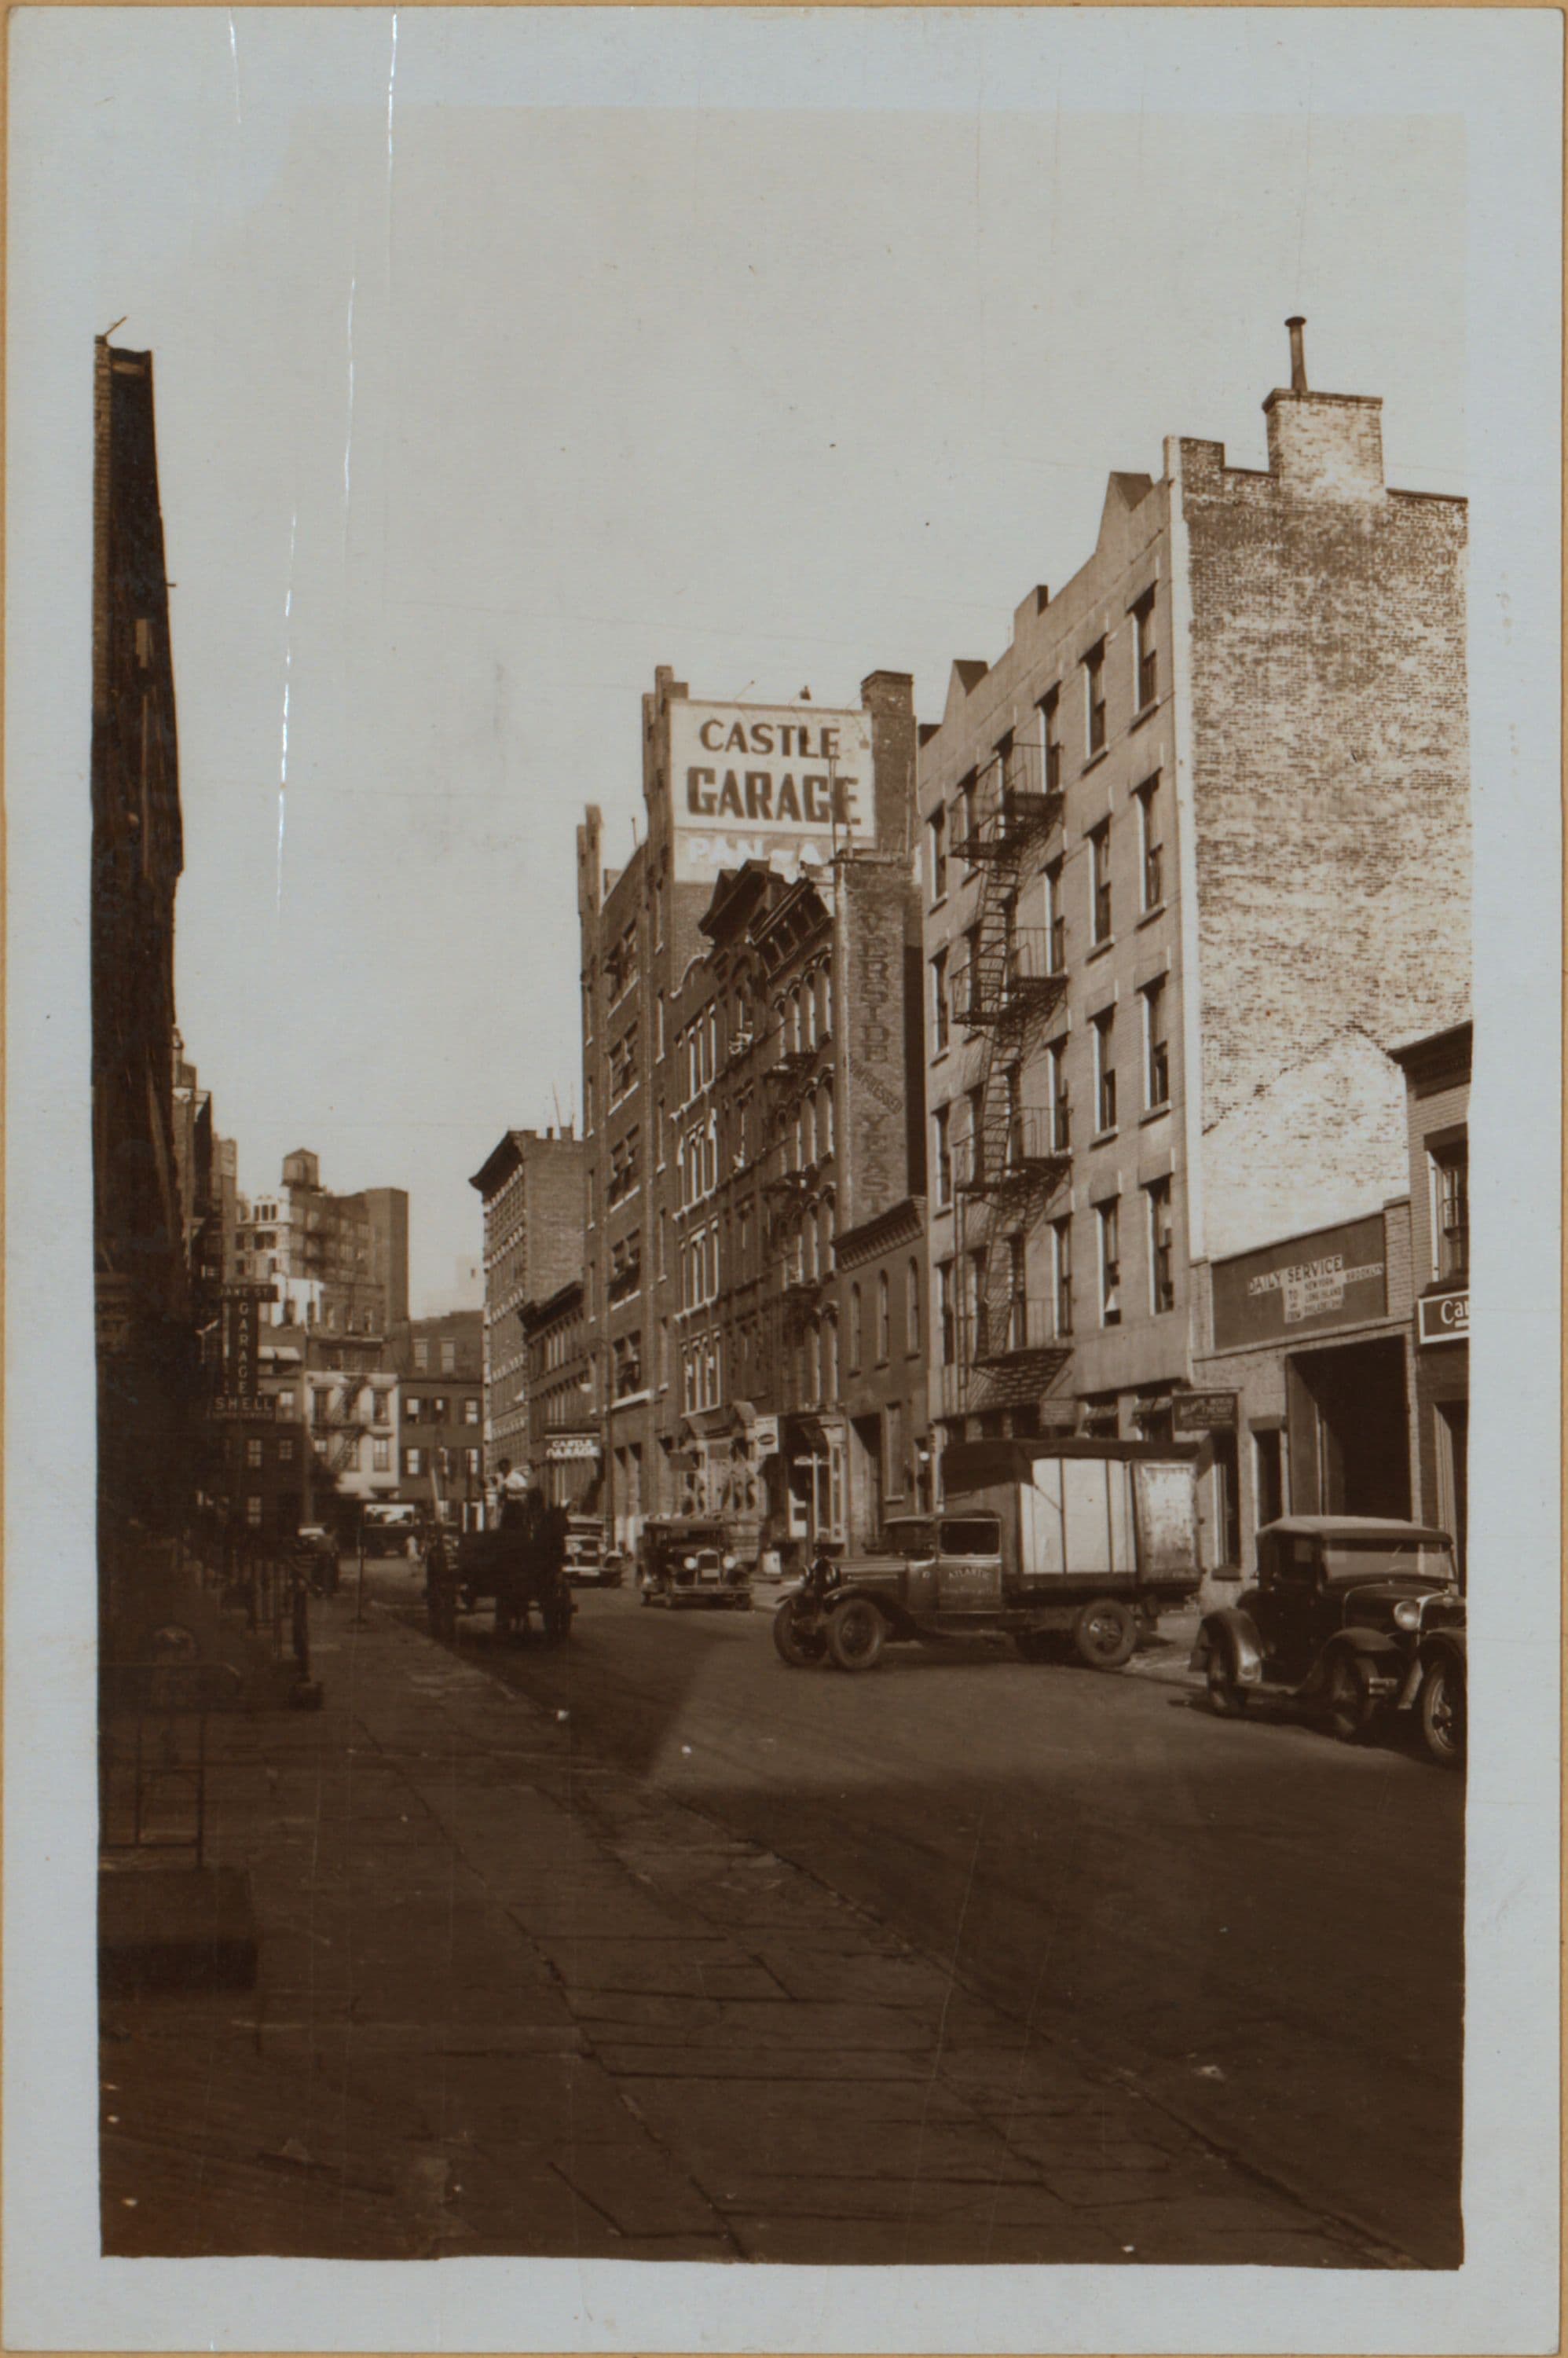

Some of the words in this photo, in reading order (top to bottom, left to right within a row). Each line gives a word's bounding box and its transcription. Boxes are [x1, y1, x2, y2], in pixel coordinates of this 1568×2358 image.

[698, 718, 840, 761] CASTLE
[687, 765, 862, 826] GARAGE
[861, 1113, 891, 1215] YEAST
[1249, 1271, 1281, 1293] DAILY
[1288, 1256, 1343, 1284] SERVICE
[1345, 1263, 1383, 1282] BROOKLYN
[1288, 1289, 1299, 1302] TO
[238, 1302, 249, 1394] GARAGE
[214, 1396, 272, 1411] SHELL
